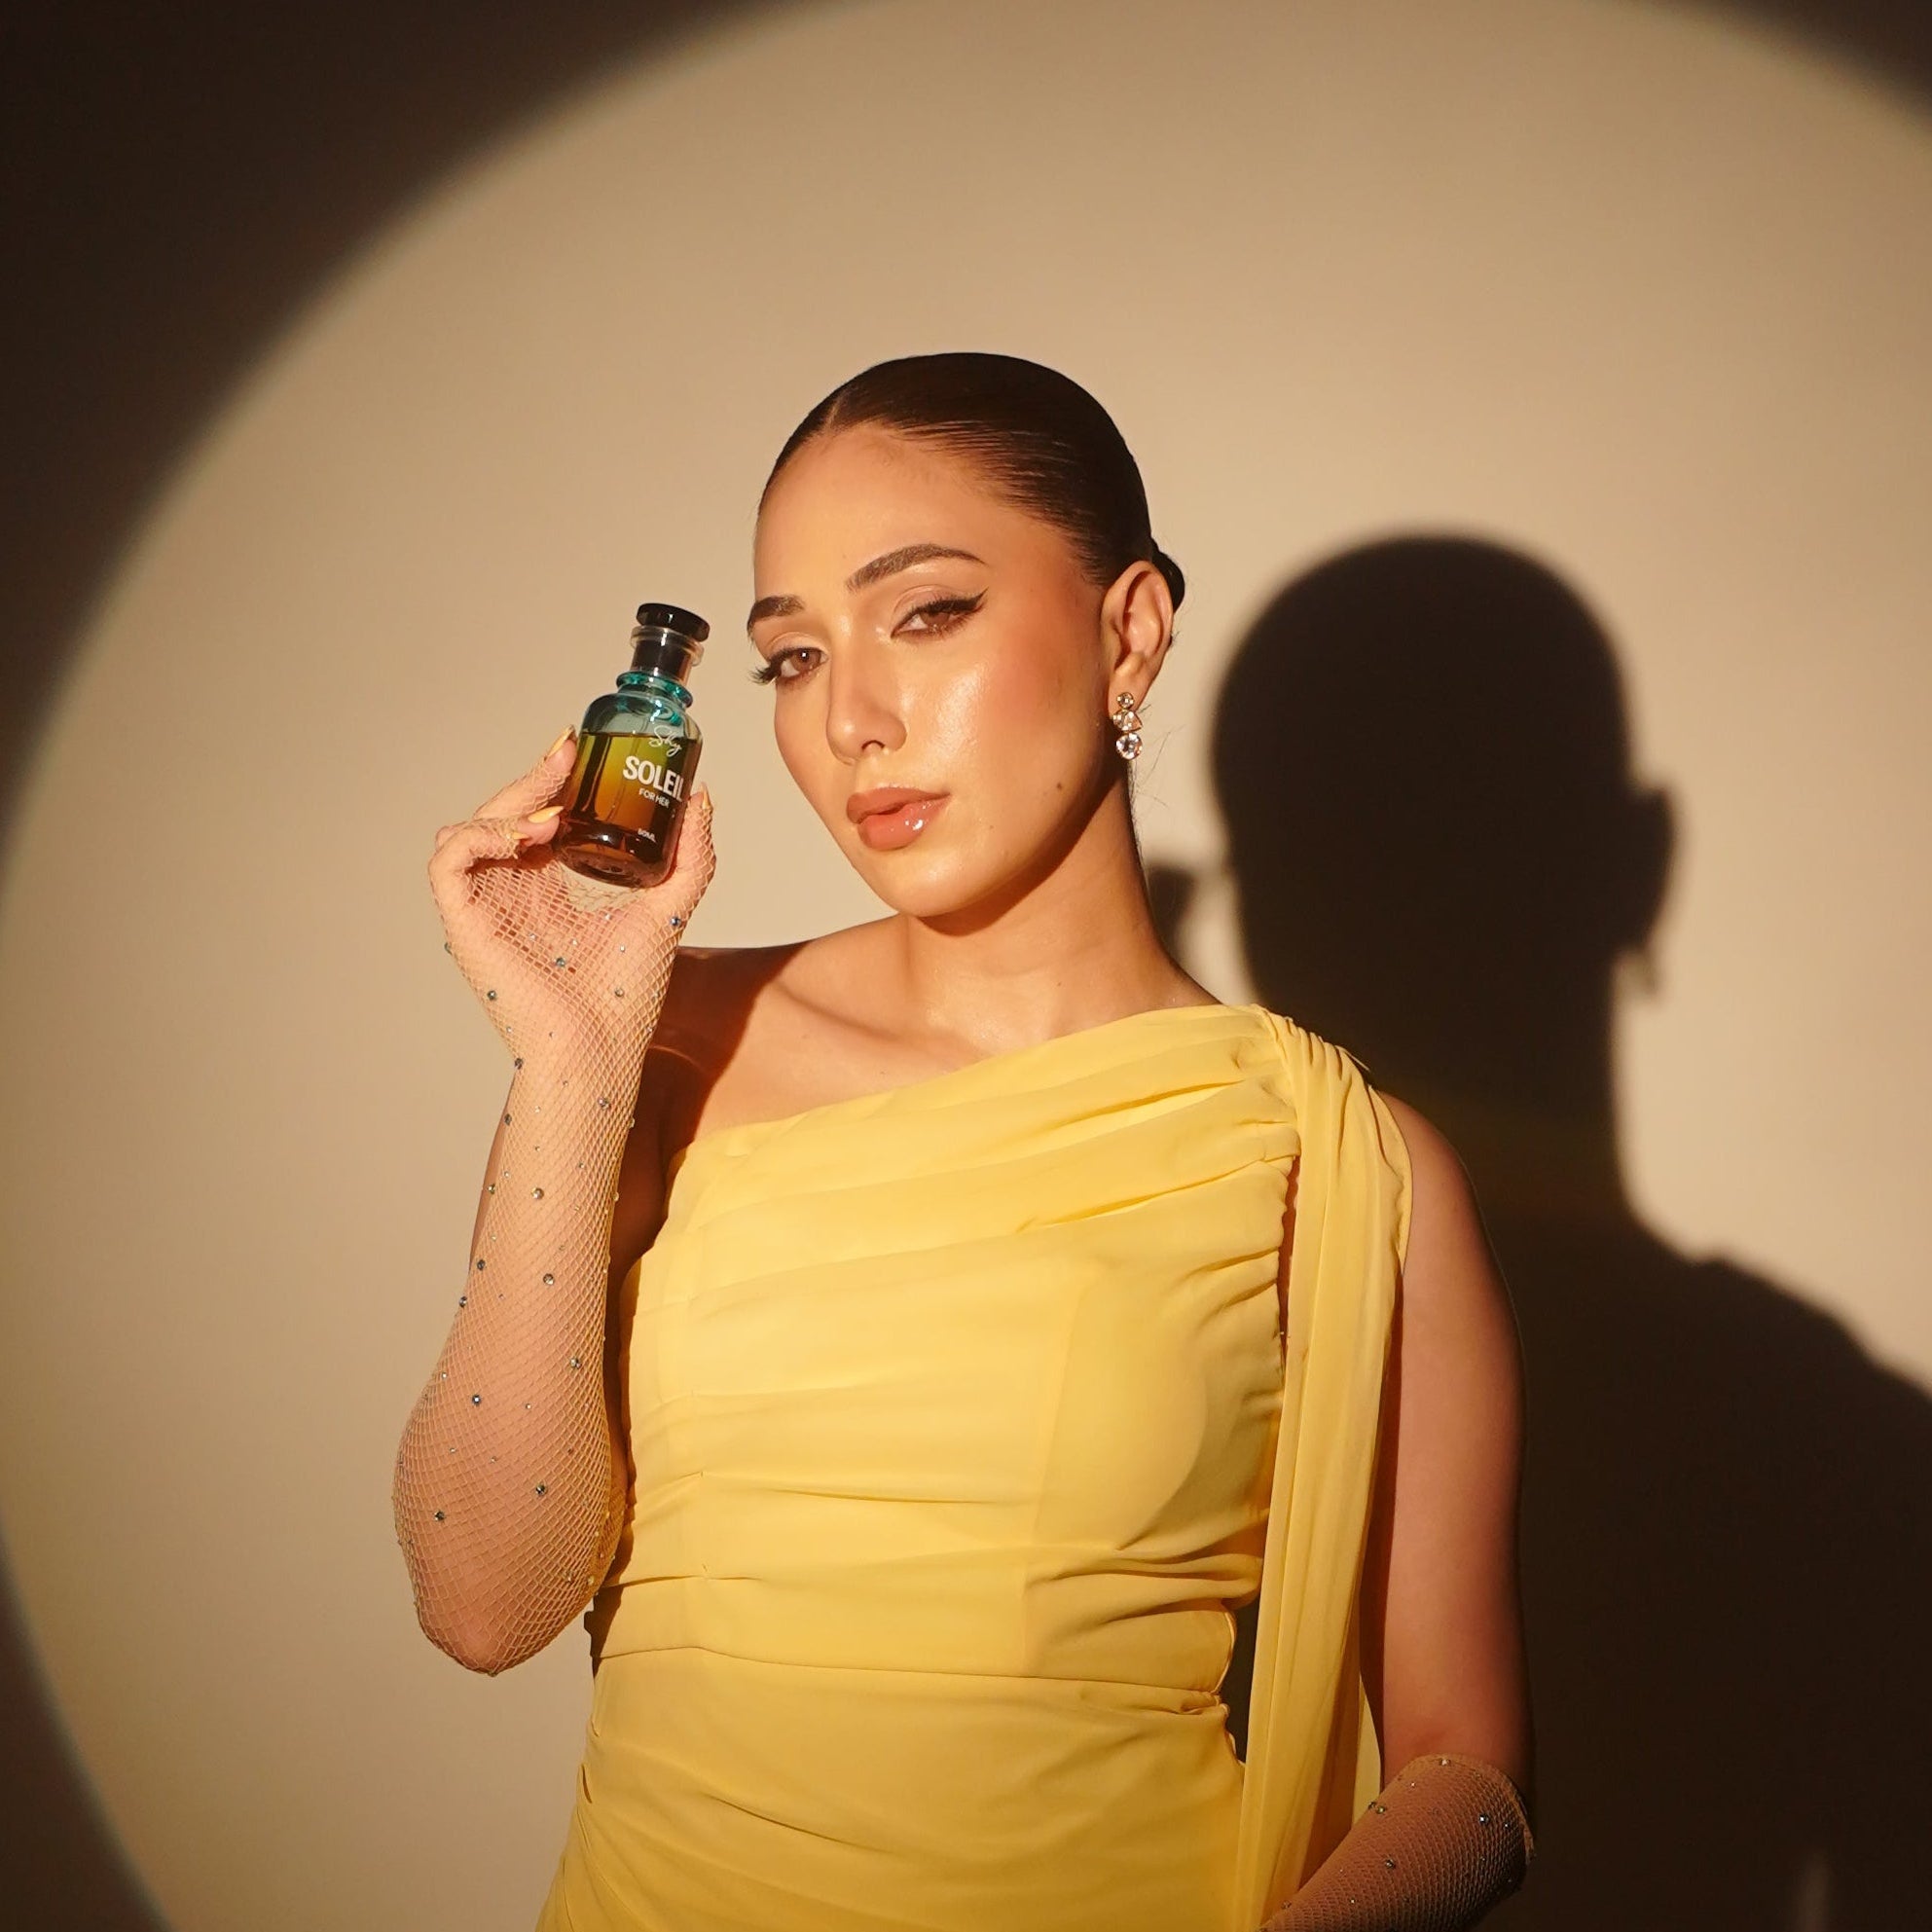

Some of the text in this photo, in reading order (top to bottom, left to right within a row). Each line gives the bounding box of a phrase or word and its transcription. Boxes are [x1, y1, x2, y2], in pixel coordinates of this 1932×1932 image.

[623, 755, 684, 802] SOLEIL
[638, 787, 670, 809] FOR HER
